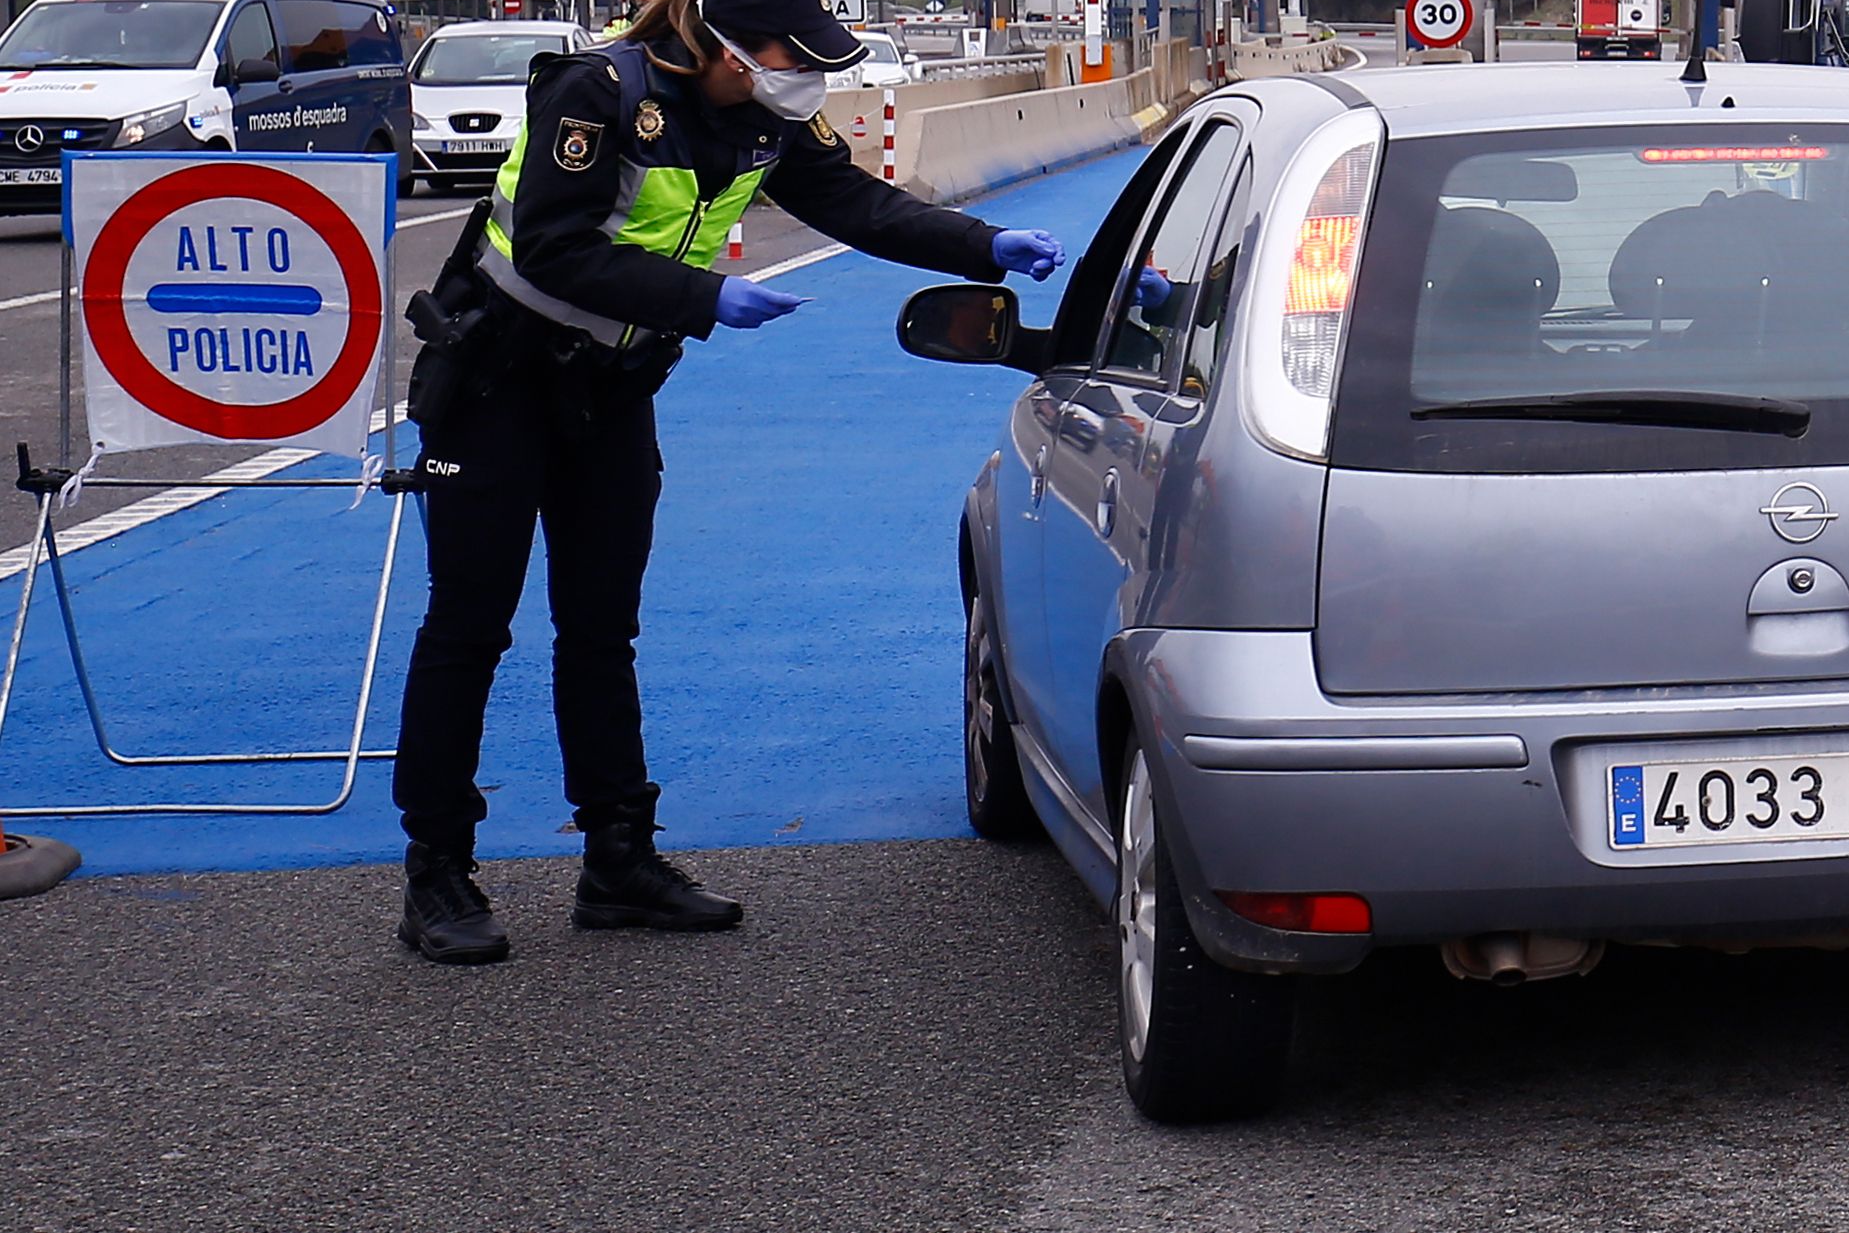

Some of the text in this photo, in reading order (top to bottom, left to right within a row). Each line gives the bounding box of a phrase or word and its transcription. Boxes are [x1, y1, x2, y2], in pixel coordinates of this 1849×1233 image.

[1421, 4, 1457, 25] 30
[249, 102, 347, 131] mossos d'esquadra
[27, 170, 59, 182] 4794
[177, 226, 290, 273] ALTO
[167, 327, 313, 376] POLICIA
[426, 459, 461, 477] CNP
[1653, 766, 1824, 834] 4033
[1621, 813, 1636, 832] E
